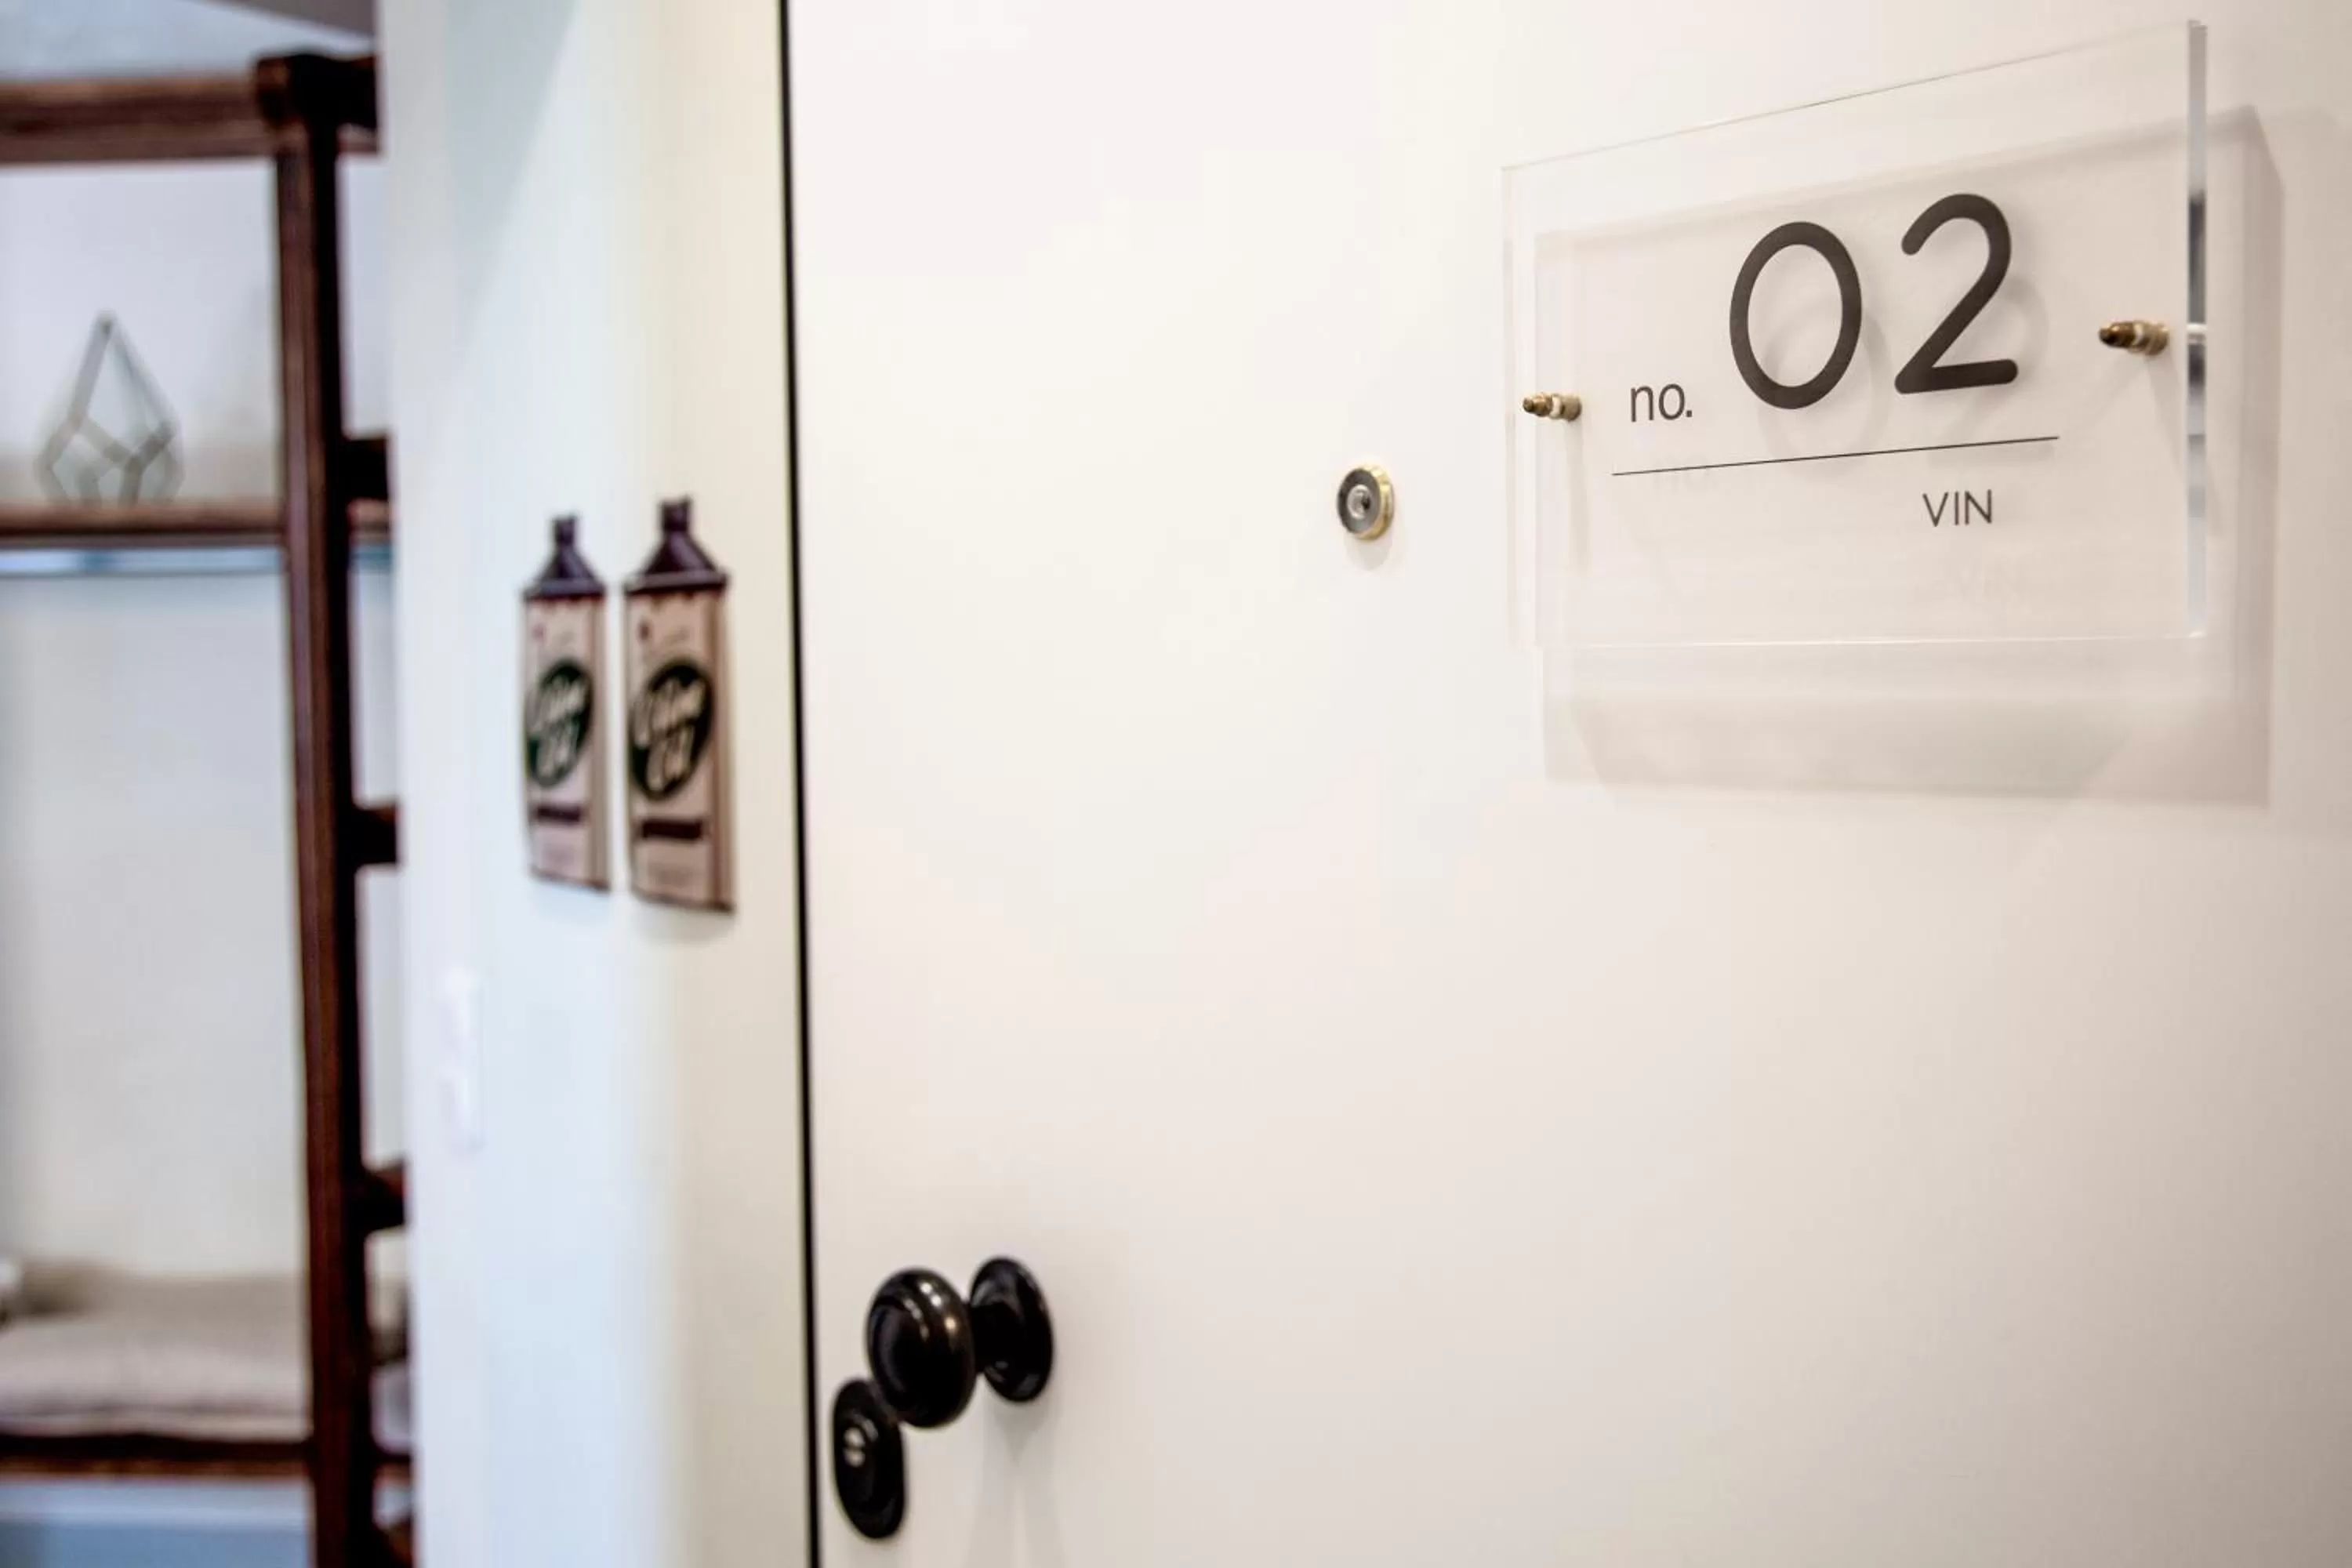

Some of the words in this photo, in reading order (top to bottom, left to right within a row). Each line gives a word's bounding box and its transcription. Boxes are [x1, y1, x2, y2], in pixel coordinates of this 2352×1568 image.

[1630, 383, 1693, 423] no.
[1729, 193, 2020, 411] 02
[1922, 488, 1993, 528] VIN
